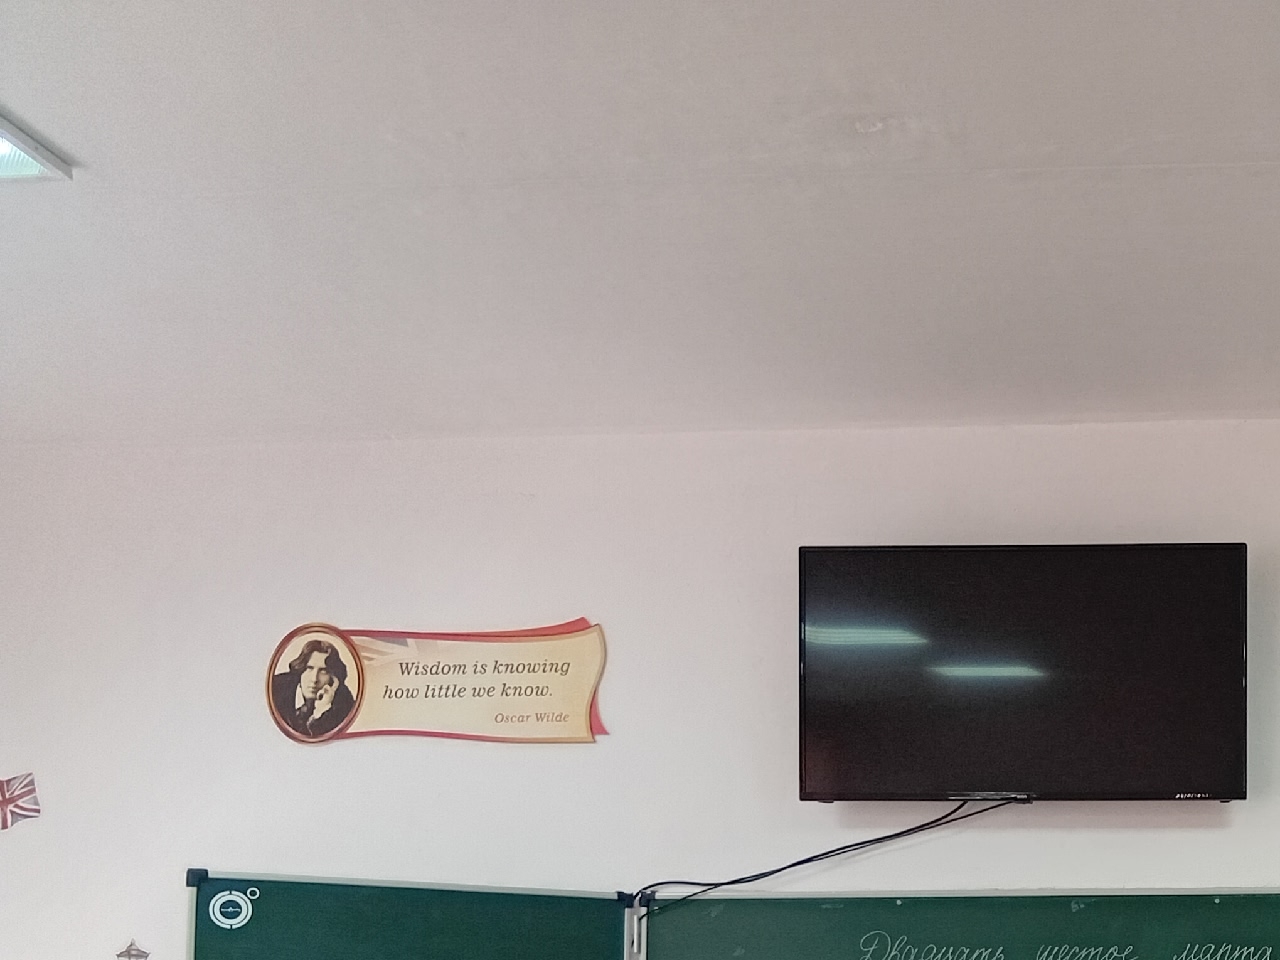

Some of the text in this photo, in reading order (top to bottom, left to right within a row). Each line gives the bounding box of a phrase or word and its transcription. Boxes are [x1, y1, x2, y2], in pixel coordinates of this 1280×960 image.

[398, 659, 571, 676] Wisdom is knowing
[383, 683, 553, 699] how little we know.
[494, 712, 570, 723] Oscar Wilde
